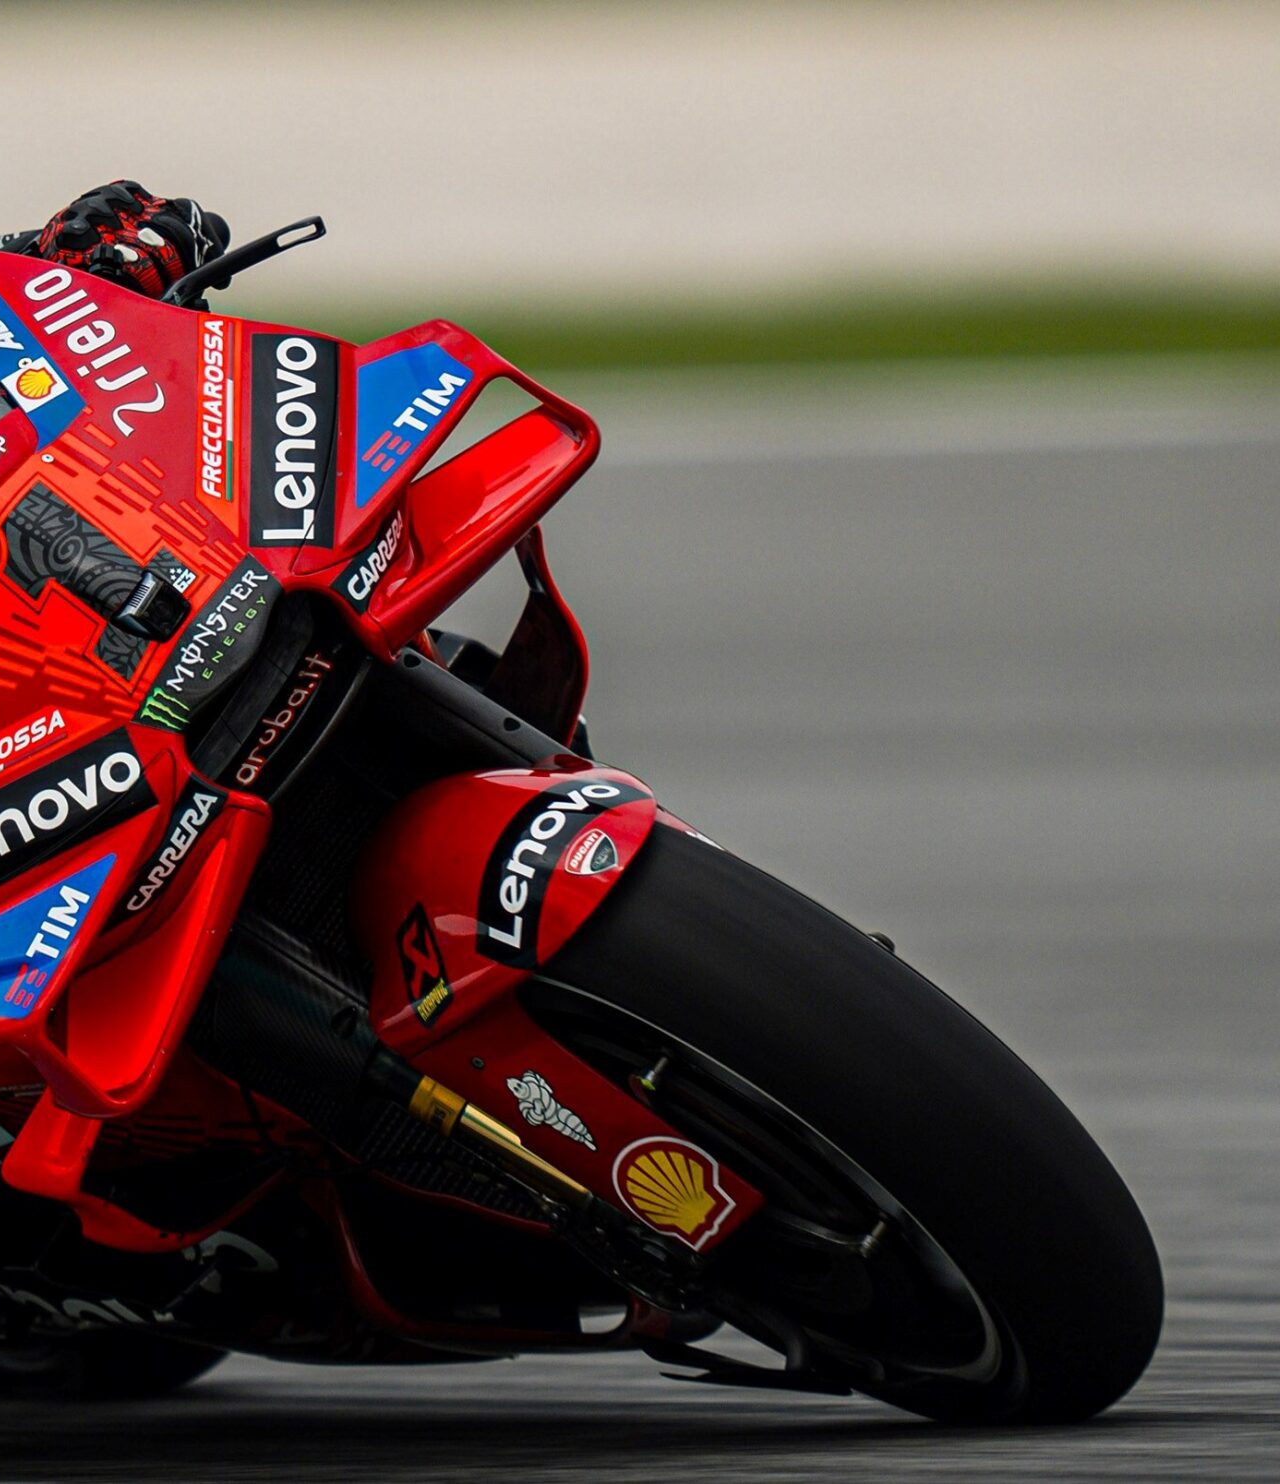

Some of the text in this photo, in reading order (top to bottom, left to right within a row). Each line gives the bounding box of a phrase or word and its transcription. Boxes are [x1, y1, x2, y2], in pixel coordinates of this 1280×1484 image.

[201, 320, 224, 499] FRECCIAROSSA
[261, 336, 317, 541] Lenovo
[392, 371, 467, 433] TIM
[346, 511, 405, 601] CARRERA
[165, 568, 270, 693] MONSTER
[201, 595, 268, 681] ENERGY
[234, 653, 333, 786] aruba.it
[125, 791, 218, 911] CARRERA
[488, 782, 621, 949] Lenovo
[569, 831, 599, 869] DUCATI
[25, 885, 90, 959] TIM
